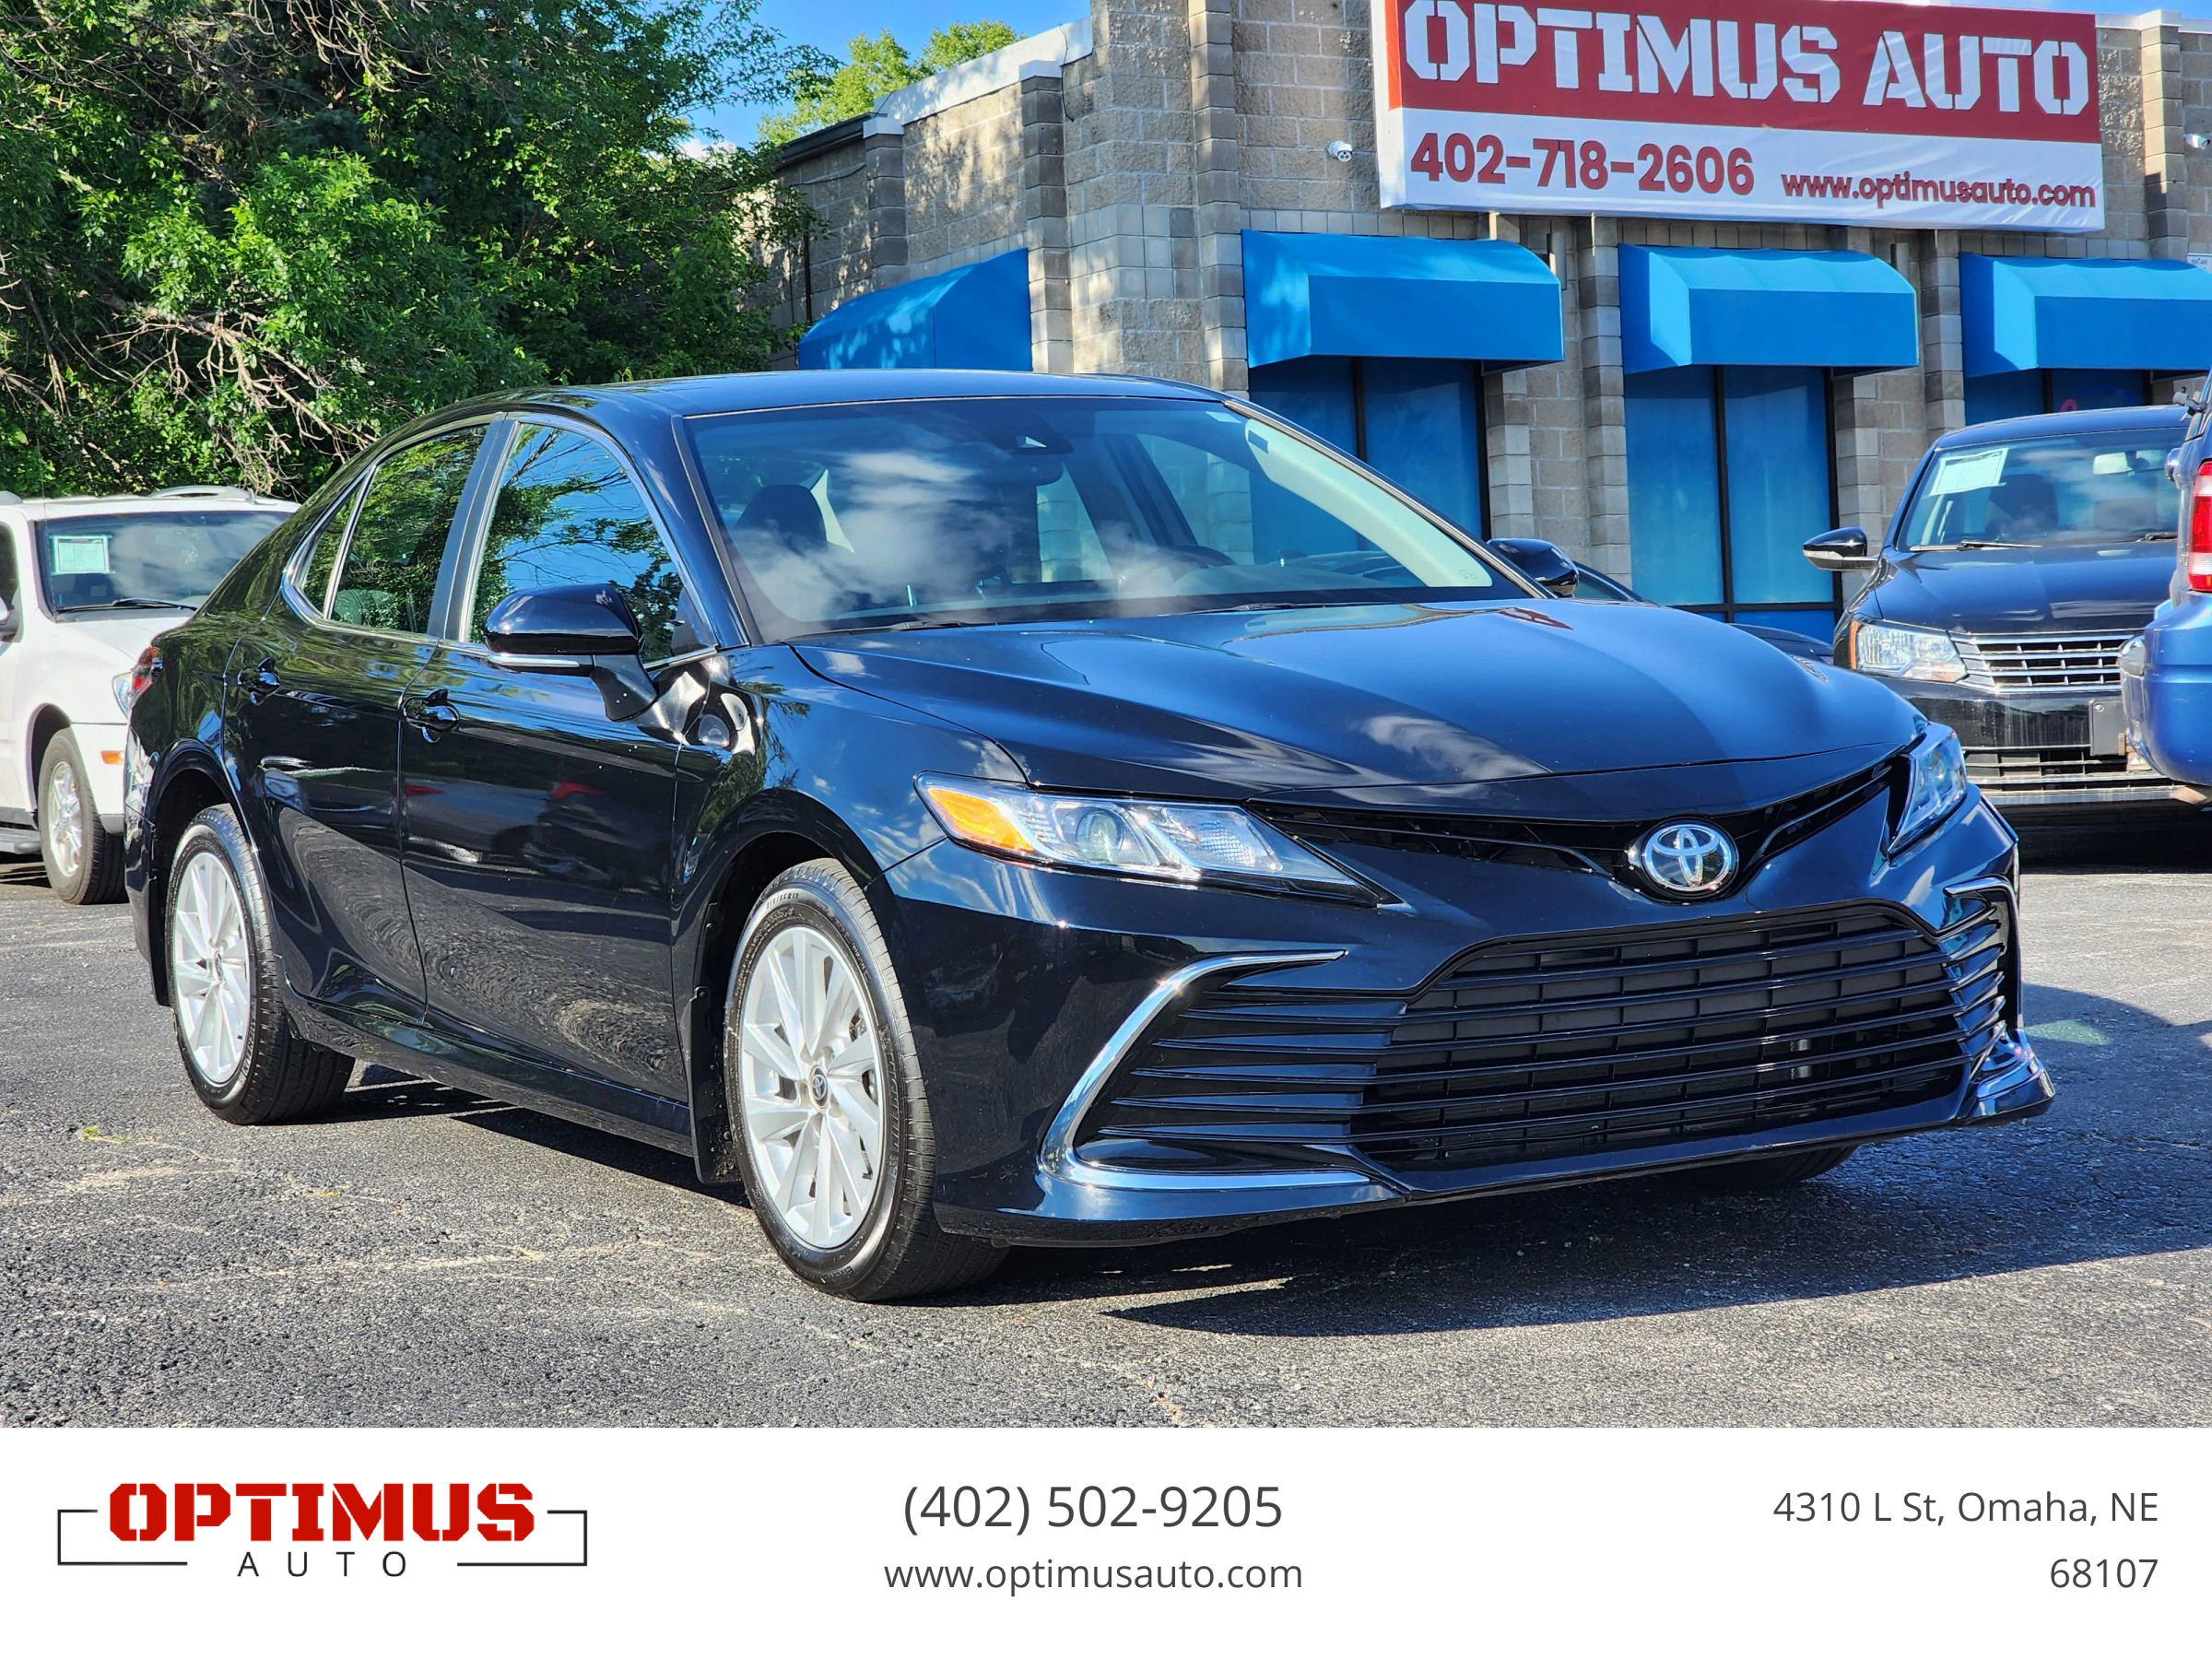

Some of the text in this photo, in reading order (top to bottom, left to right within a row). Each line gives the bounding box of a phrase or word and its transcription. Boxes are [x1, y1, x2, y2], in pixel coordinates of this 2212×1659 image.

[1404, 0, 2089, 115] OPTIMUS AUTO
[1410, 133, 1755, 195] 402-718-2606
[1781, 171, 2096, 209] www.optimusauto.com
